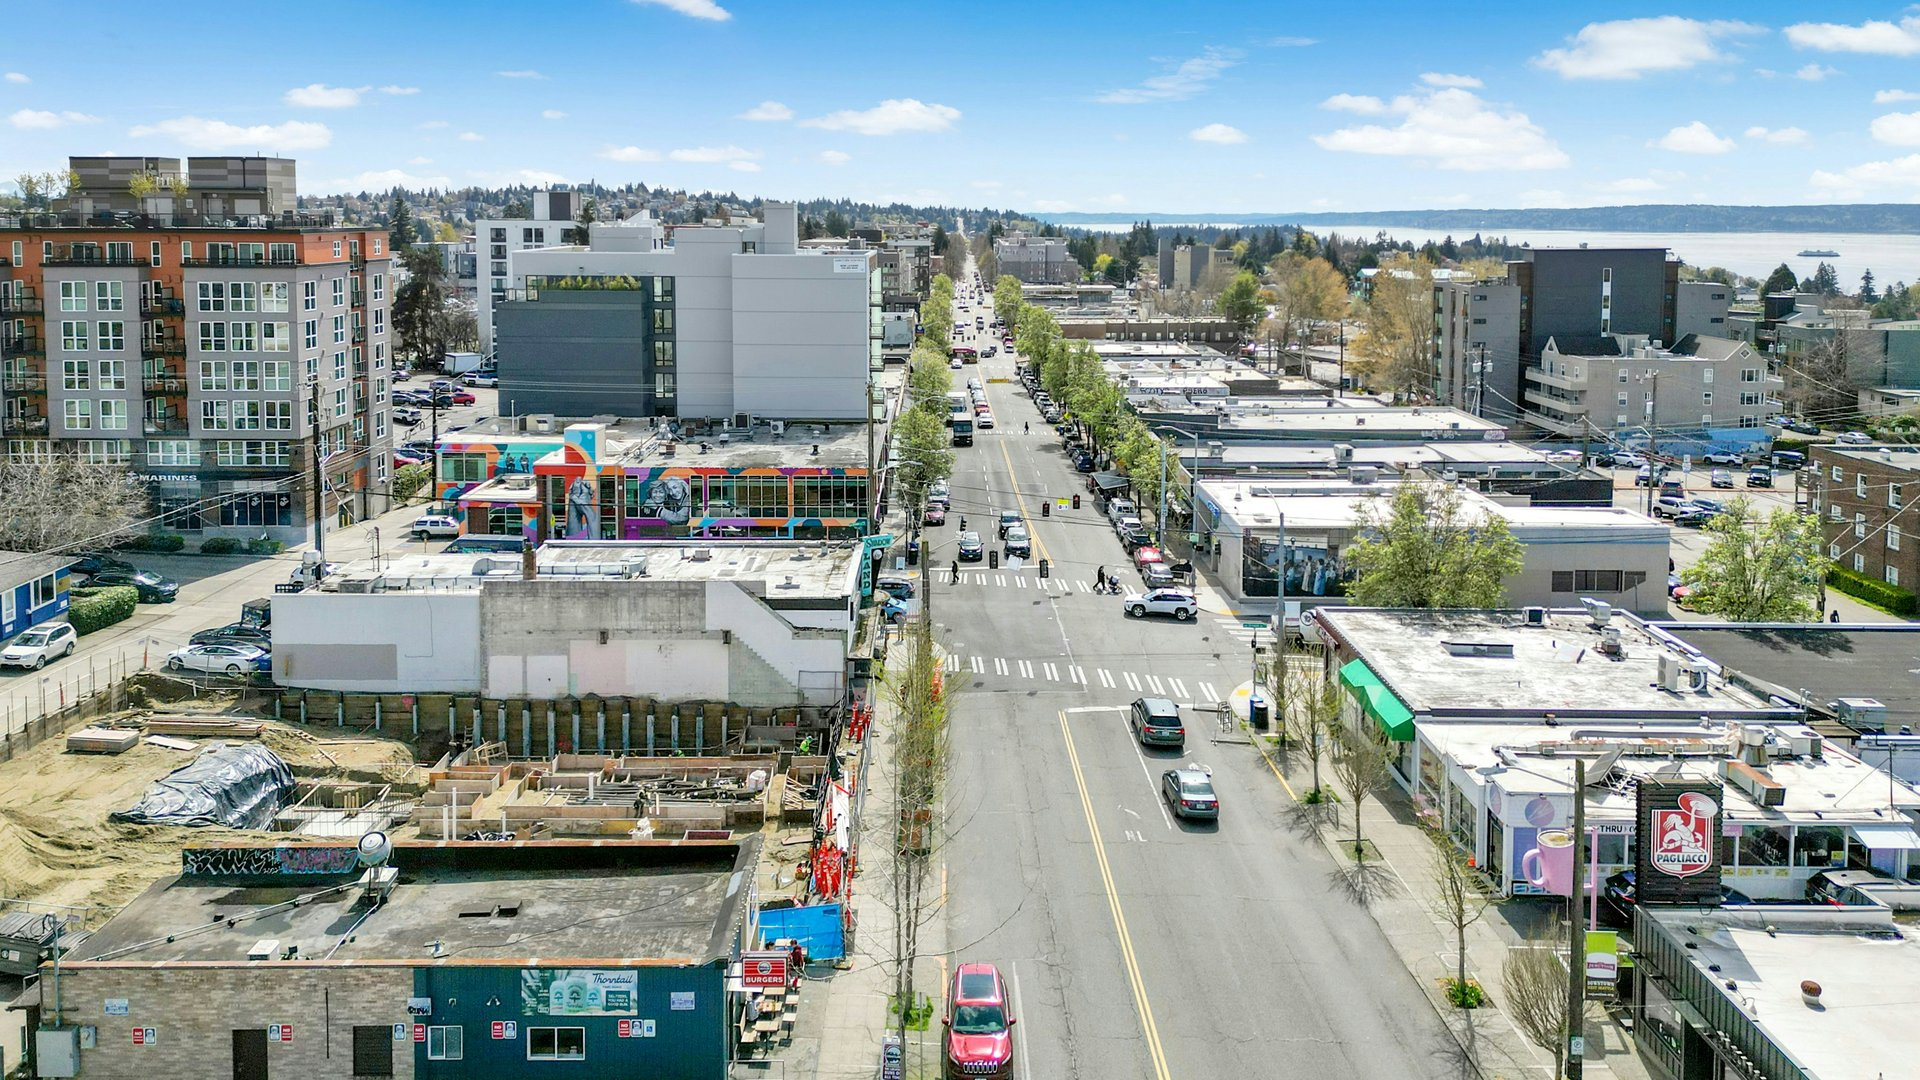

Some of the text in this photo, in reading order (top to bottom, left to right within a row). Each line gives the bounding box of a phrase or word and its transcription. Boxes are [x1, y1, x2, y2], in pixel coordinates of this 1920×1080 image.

[139, 474, 198, 482] MARINES
[862, 553, 872, 589] LAND
[1600, 825, 1623, 833] THRU
[1656, 854, 1707, 863] PAGLIACCI
[592, 972, 634, 984] Thorntail
[745, 976, 784, 984] BURGERS
